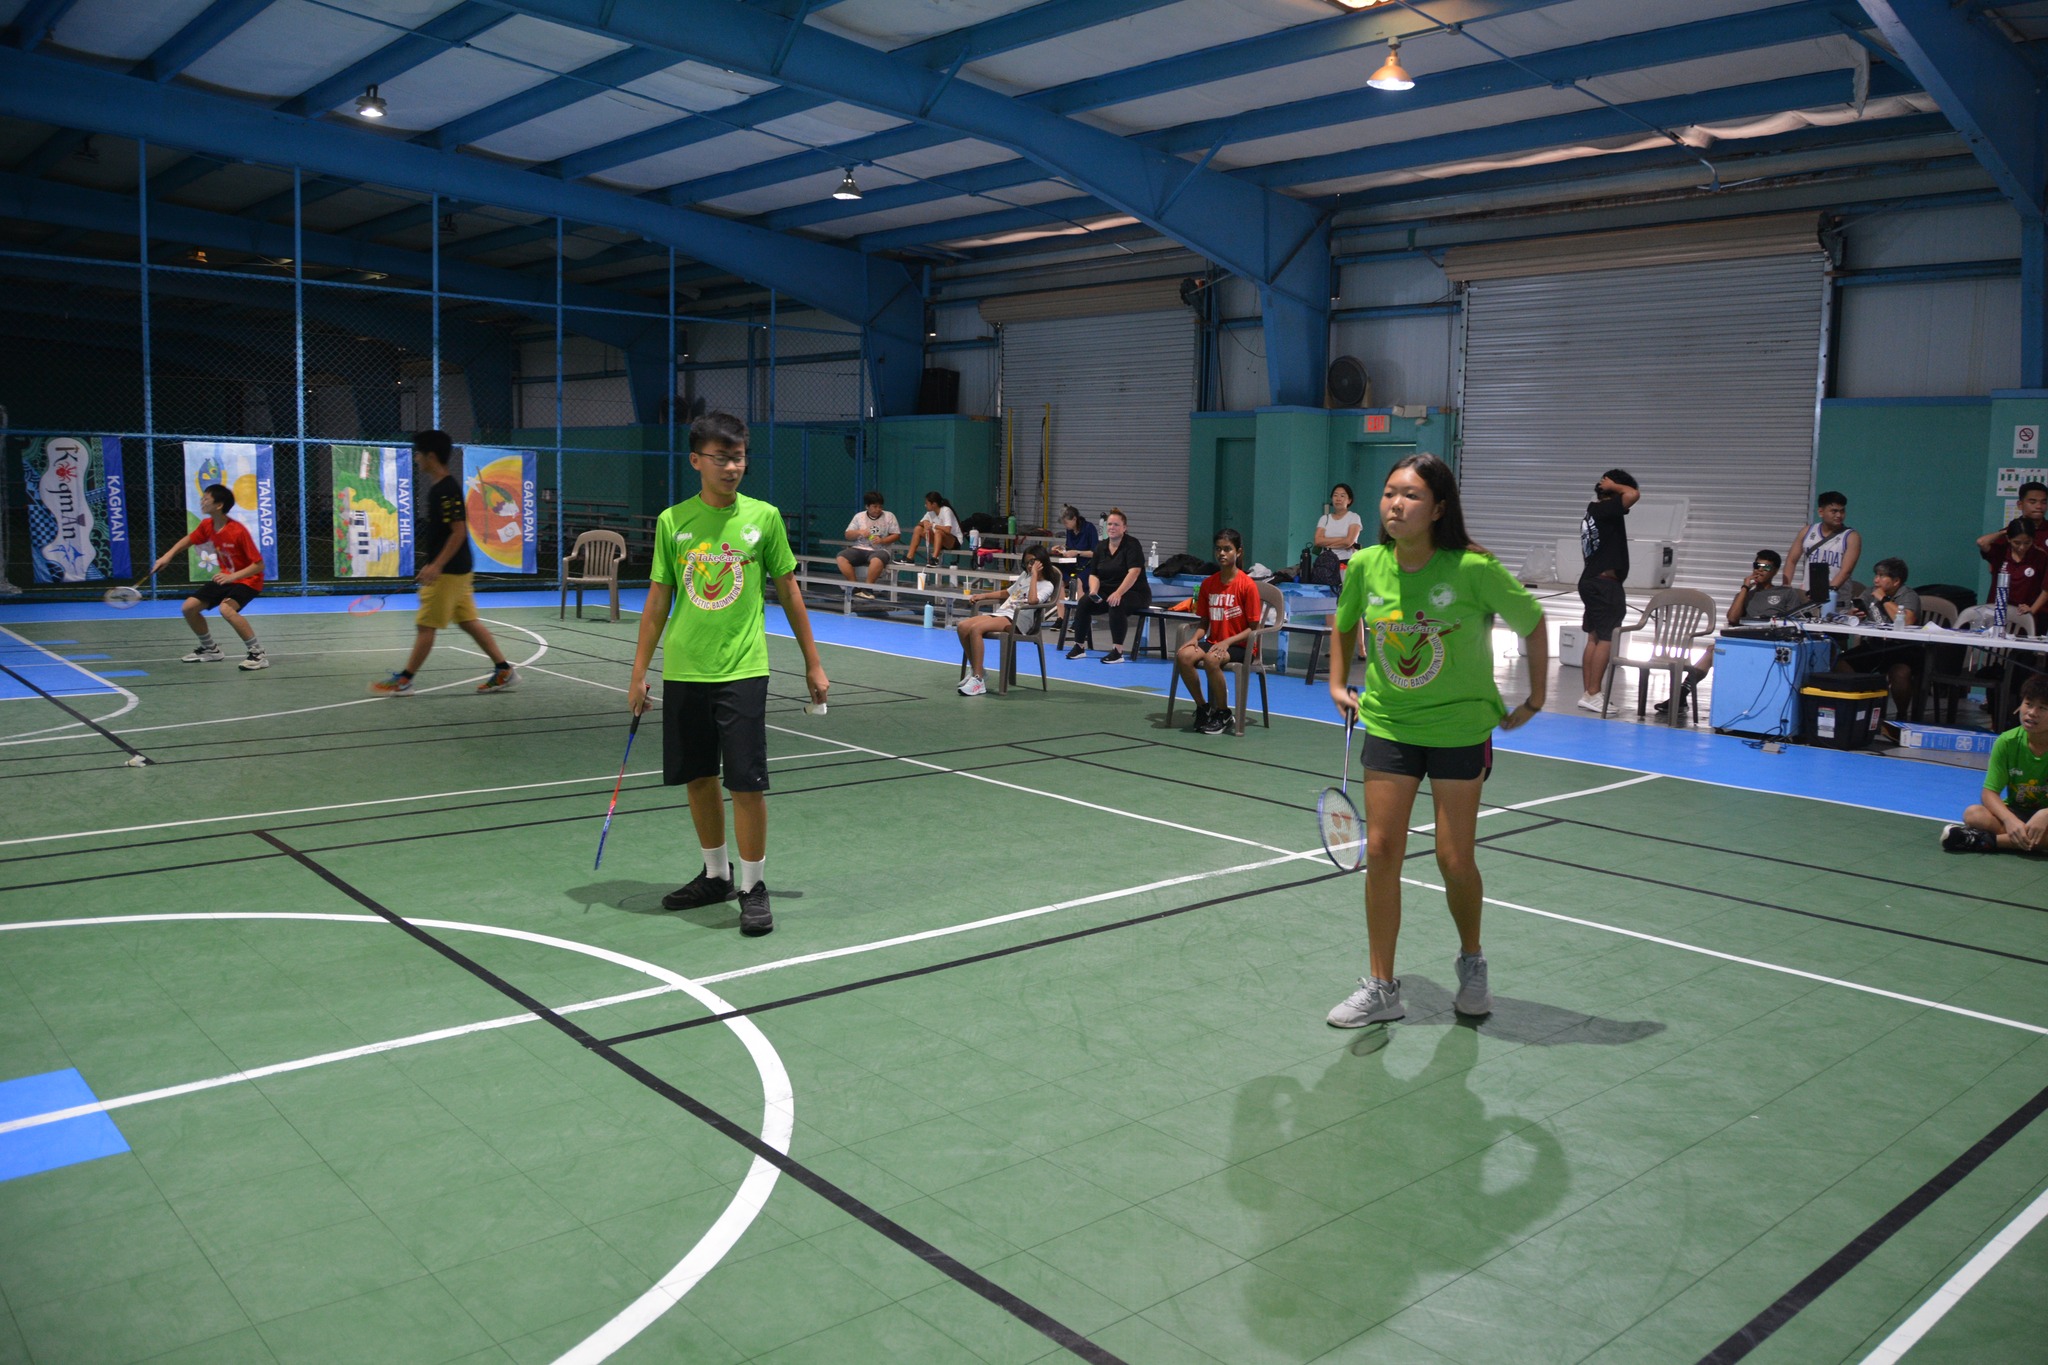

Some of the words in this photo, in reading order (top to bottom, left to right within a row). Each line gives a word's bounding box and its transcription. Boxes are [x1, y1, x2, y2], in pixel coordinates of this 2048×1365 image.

[1368, 416, 1385, 431] EXIT
[106, 475, 125, 542] KAGMAN
[258, 478, 274, 546] TANAPAG
[398, 478, 411, 514] NAVY
[523, 480, 534, 542] GARAPAN
[399, 515, 411, 547] HILL
[698, 553, 741, 562] TakeCare
[711, 586, 741, 609] BADMINTON
[1410, 660, 1441, 688] BADMINTON
